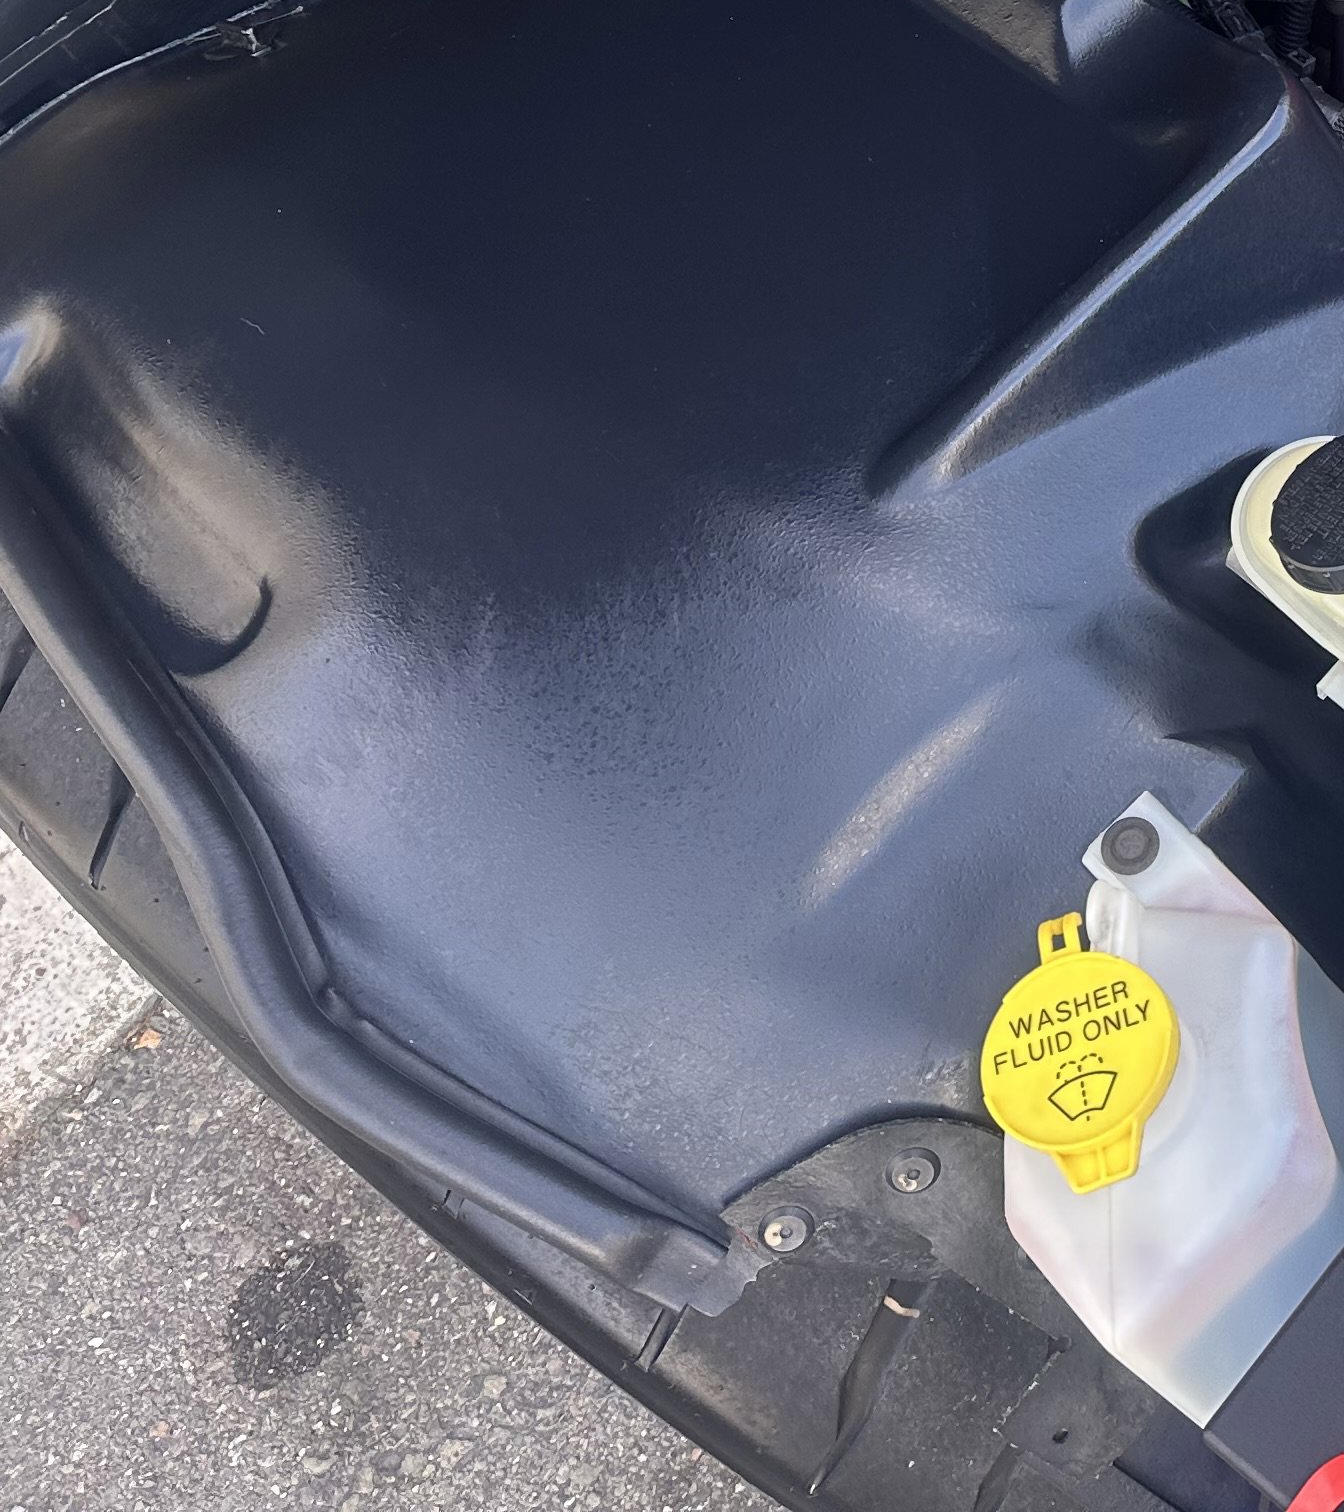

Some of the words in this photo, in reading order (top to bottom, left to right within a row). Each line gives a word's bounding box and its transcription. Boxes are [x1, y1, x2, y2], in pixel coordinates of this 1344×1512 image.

[993, 1031, 1072, 1075] FLUID
[1083, 999, 1150, 1041] ONLY
[1009, 980, 1129, 1039] WASHER
